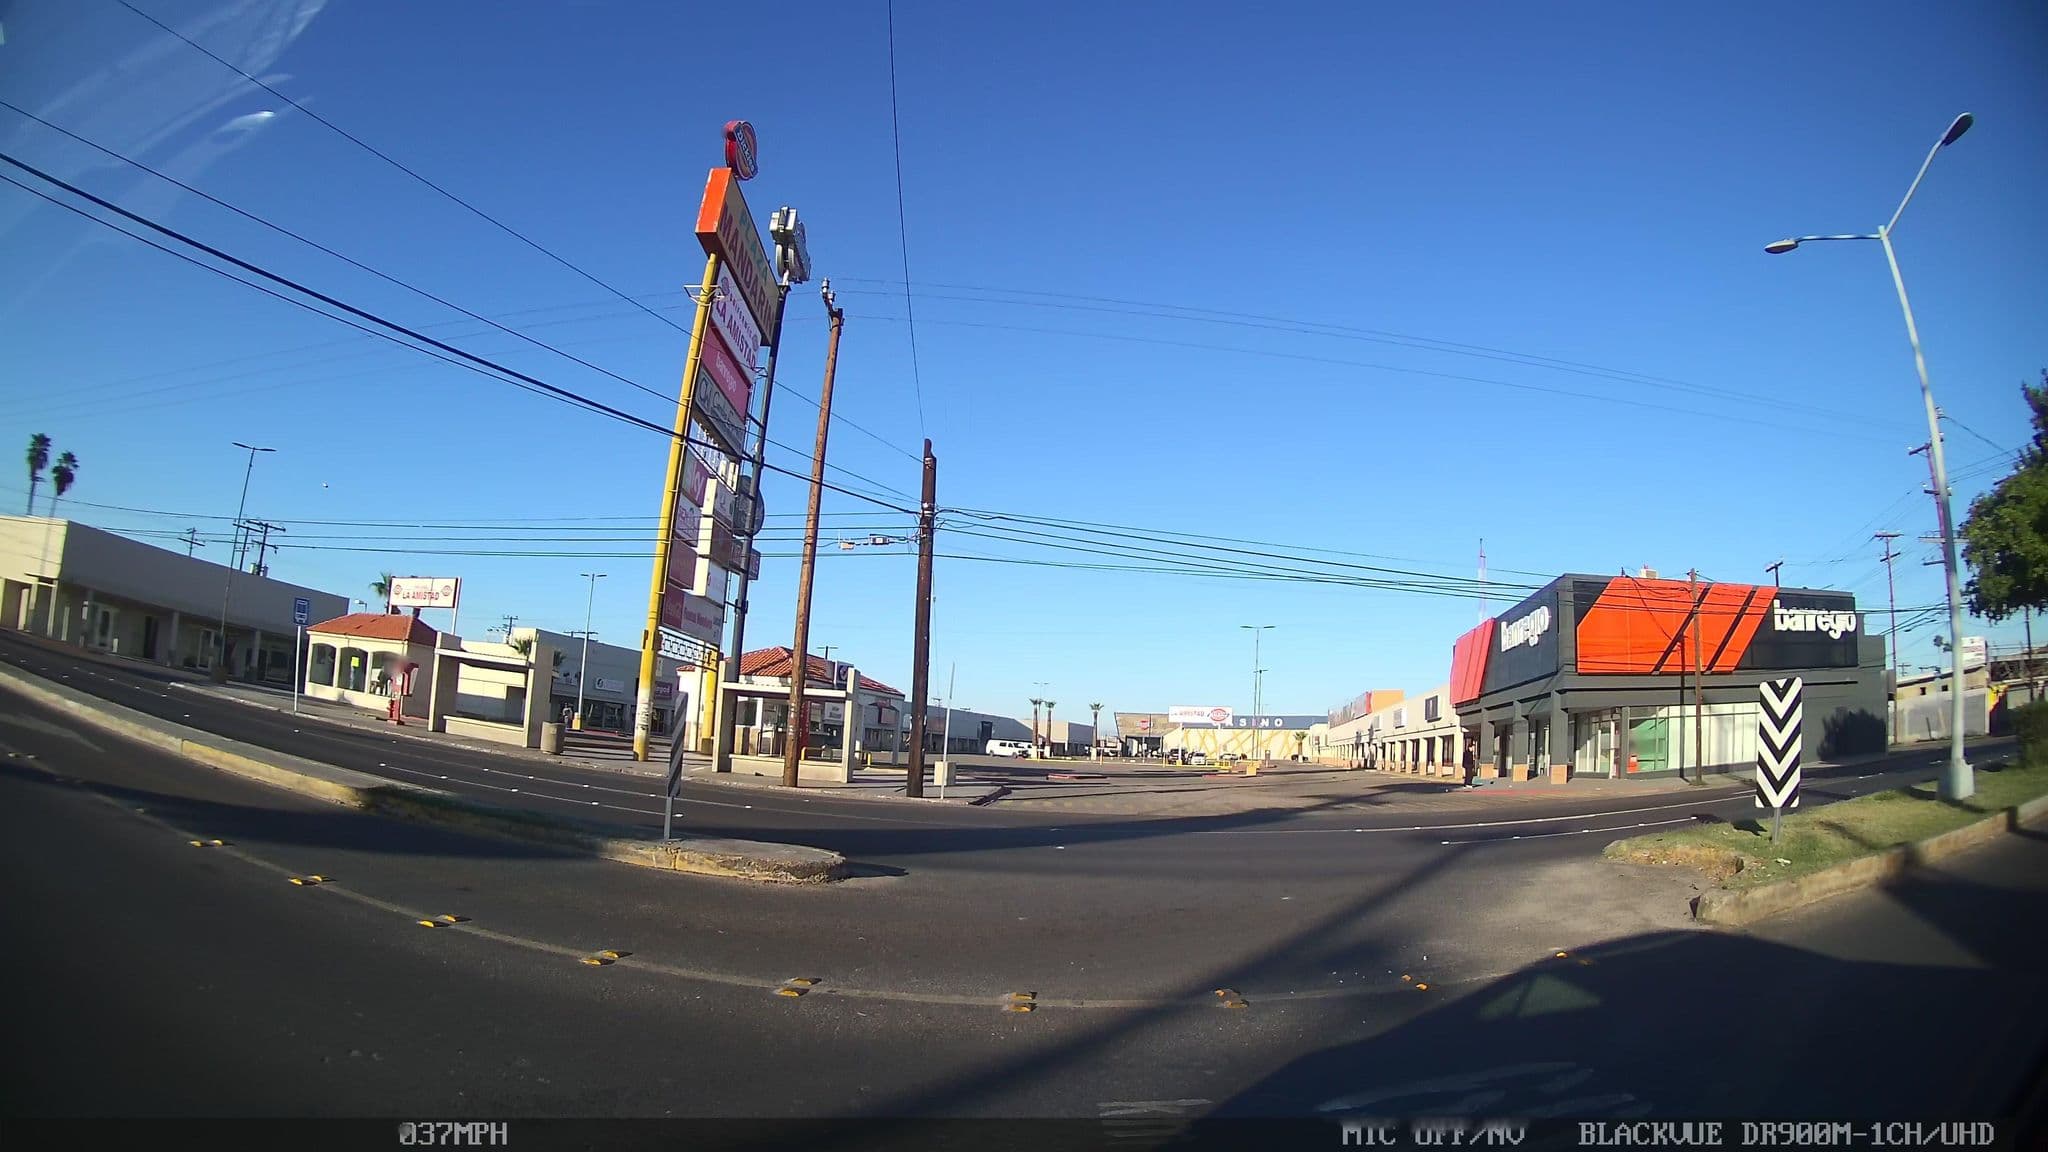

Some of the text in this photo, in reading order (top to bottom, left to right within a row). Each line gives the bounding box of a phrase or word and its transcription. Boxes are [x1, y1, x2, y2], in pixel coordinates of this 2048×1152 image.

[719, 205, 776, 334] MANDARIN
[739, 206, 770, 286] PLAZA
[726, 314, 757, 370] AMISTAD
[411, 591, 440, 600] AMISTAD
[1772, 599, 1858, 640] barrego
